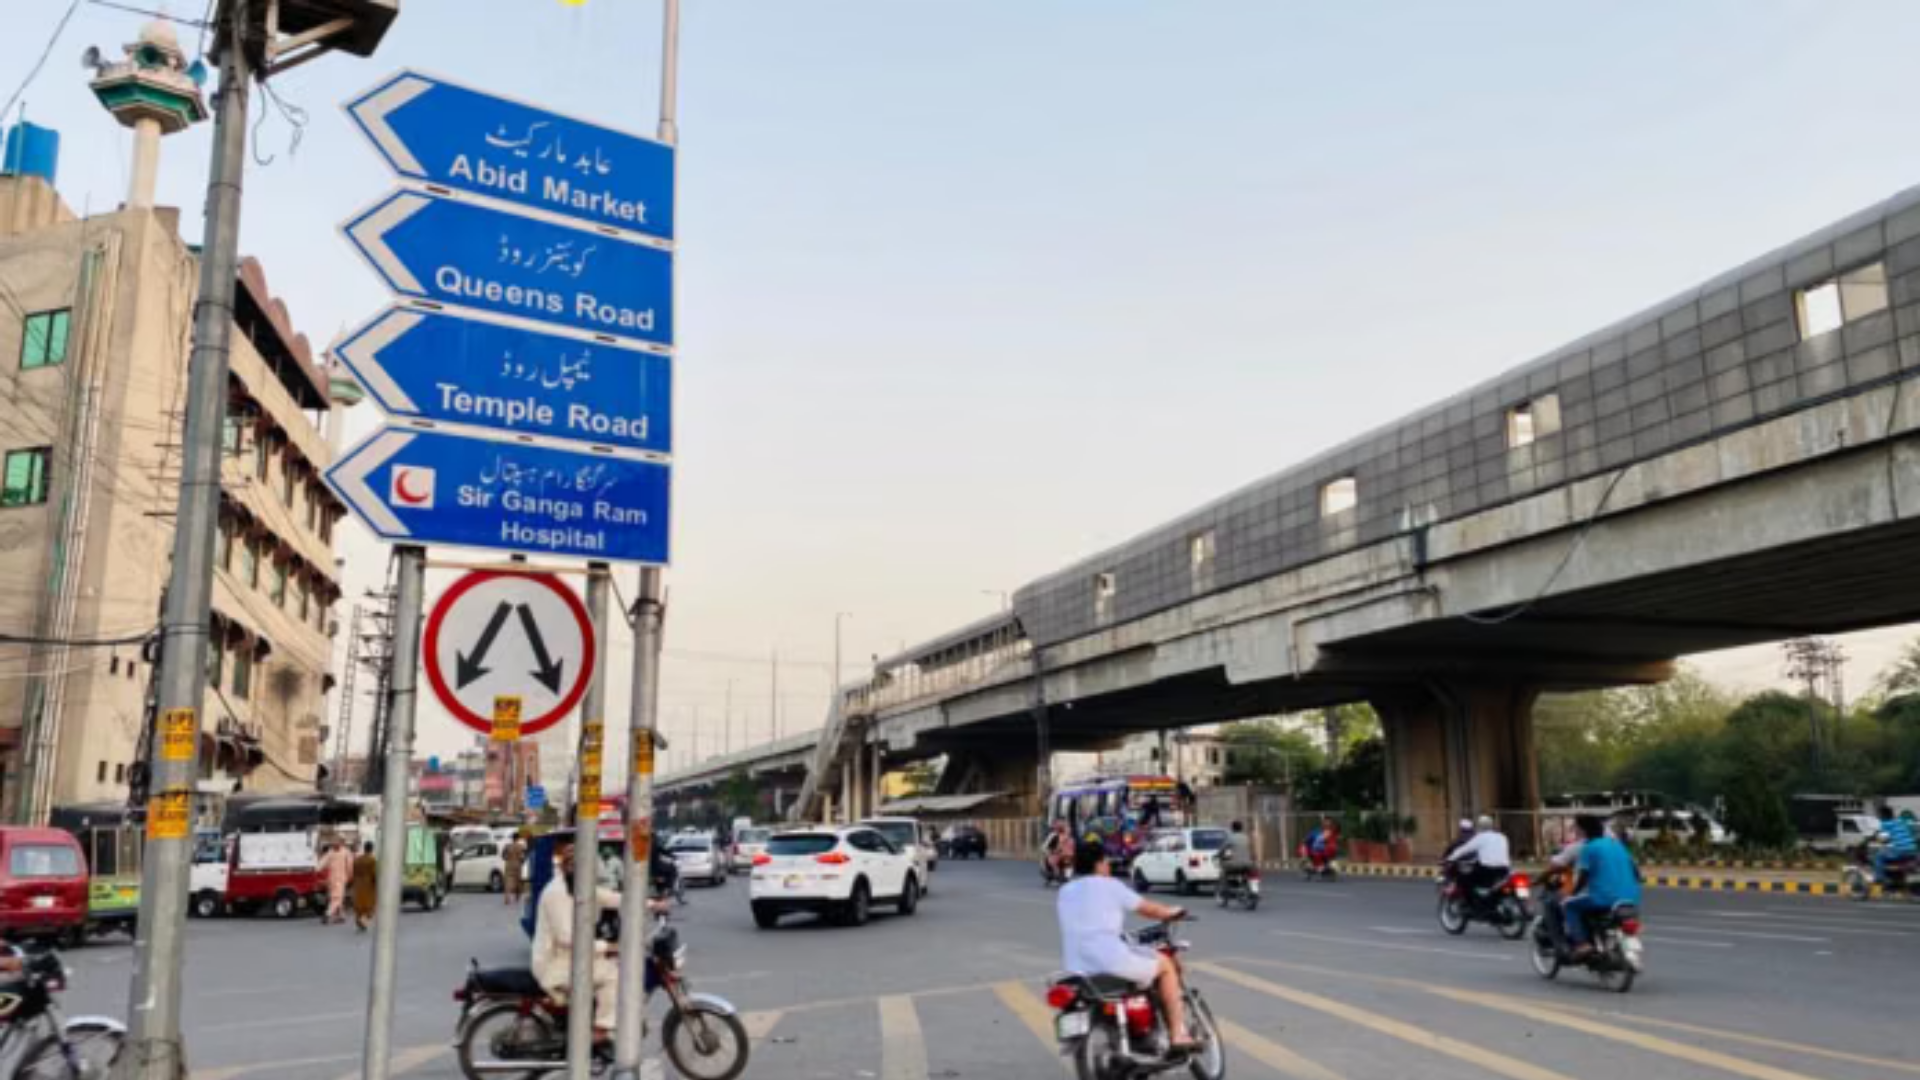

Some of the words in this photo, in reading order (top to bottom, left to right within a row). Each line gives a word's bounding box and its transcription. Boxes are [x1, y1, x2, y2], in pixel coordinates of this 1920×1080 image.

[449, 153, 528, 193] Abid
[543, 176, 647, 223] Market
[435, 264, 564, 313] Queens
[574, 294, 654, 331] Road
[435, 381, 554, 425] Temple
[567, 404, 648, 439] Road
[458, 484, 493, 507] Sir
[502, 488, 584, 520] Ganga
[595, 501, 647, 525] Ram
[500, 521, 604, 550] Hospital
